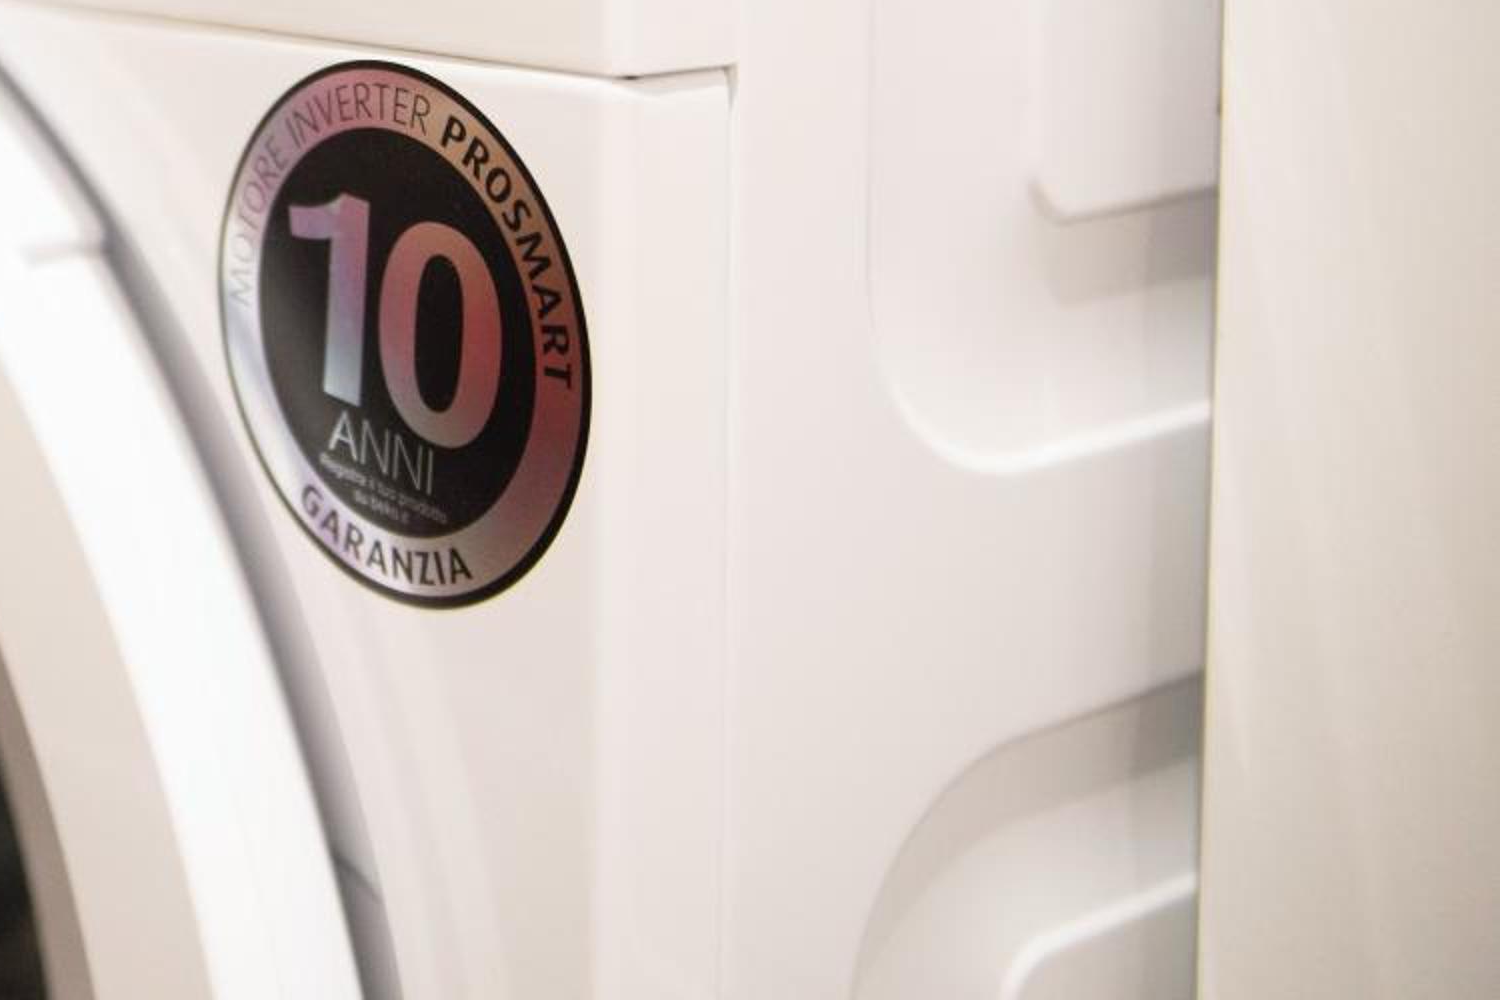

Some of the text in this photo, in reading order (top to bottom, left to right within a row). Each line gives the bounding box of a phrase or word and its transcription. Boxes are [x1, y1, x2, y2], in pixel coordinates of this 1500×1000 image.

[229, 82, 573, 391] MOTORE INVERTER PROSMART
[288, 191, 503, 450] 10
[301, 483, 474, 587] GARANZIA
[327, 410, 434, 496] ANNI
